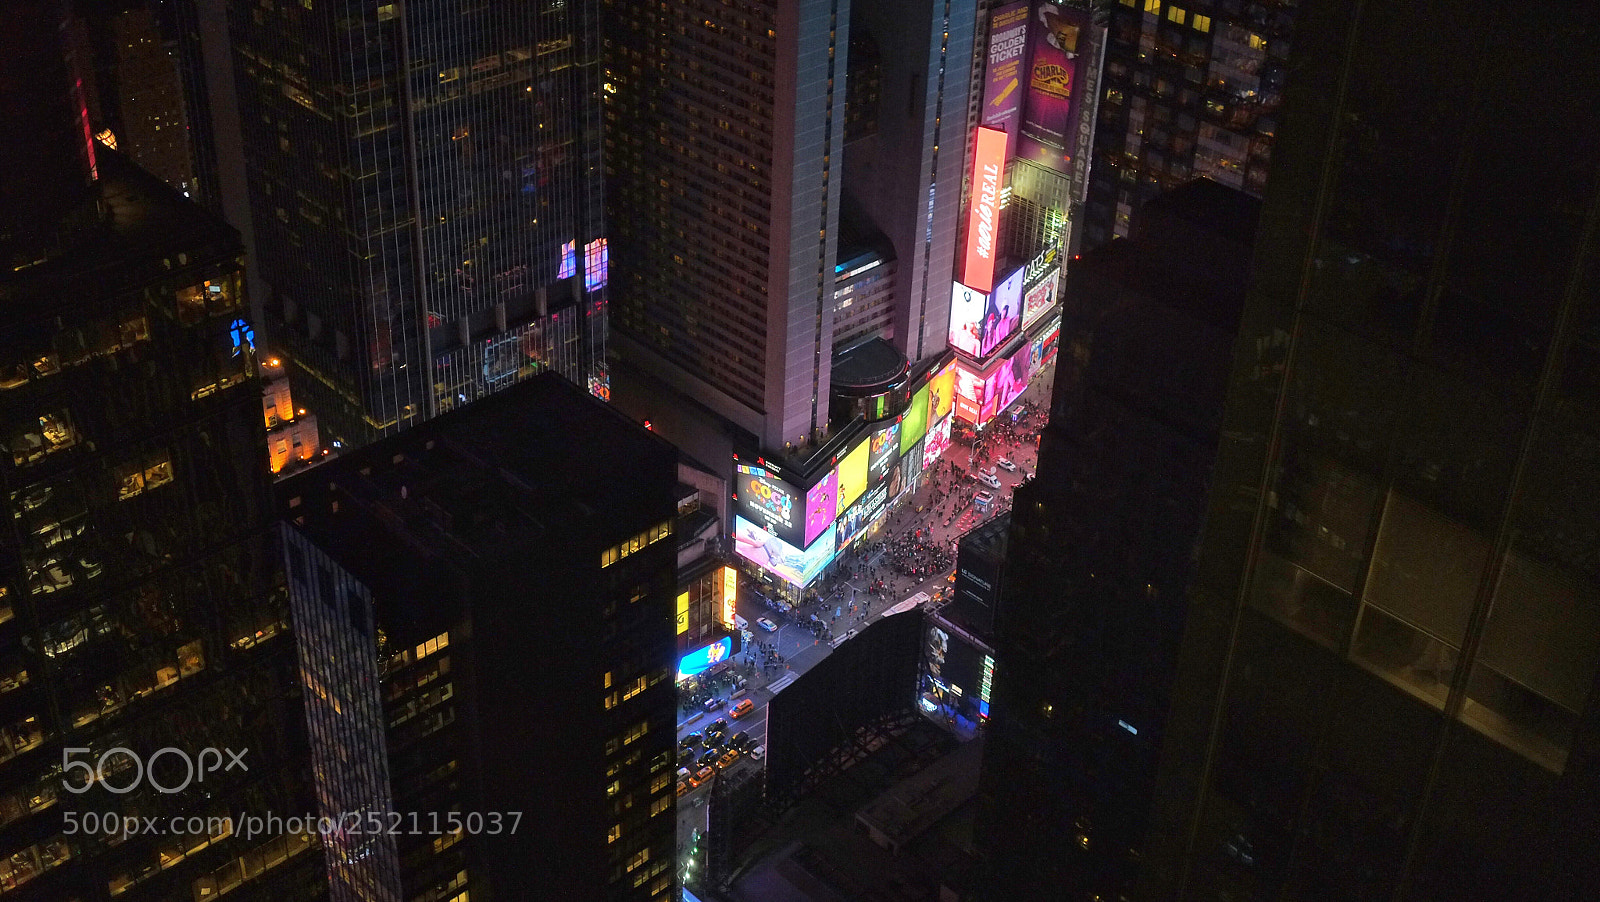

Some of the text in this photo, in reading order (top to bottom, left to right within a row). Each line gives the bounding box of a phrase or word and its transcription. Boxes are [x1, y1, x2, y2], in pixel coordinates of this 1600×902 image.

[989, 43, 1025, 65] TICKET
[990, 34, 1026, 54] GOLDEN
[1034, 64, 1067, 80] CHARLIE
[1074, 41, 1101, 185] TIMES SQUARE
[974, 163, 998, 259] #aerieREAL
[873, 423, 900, 452] COCO
[750, 480, 793, 511] COCO
